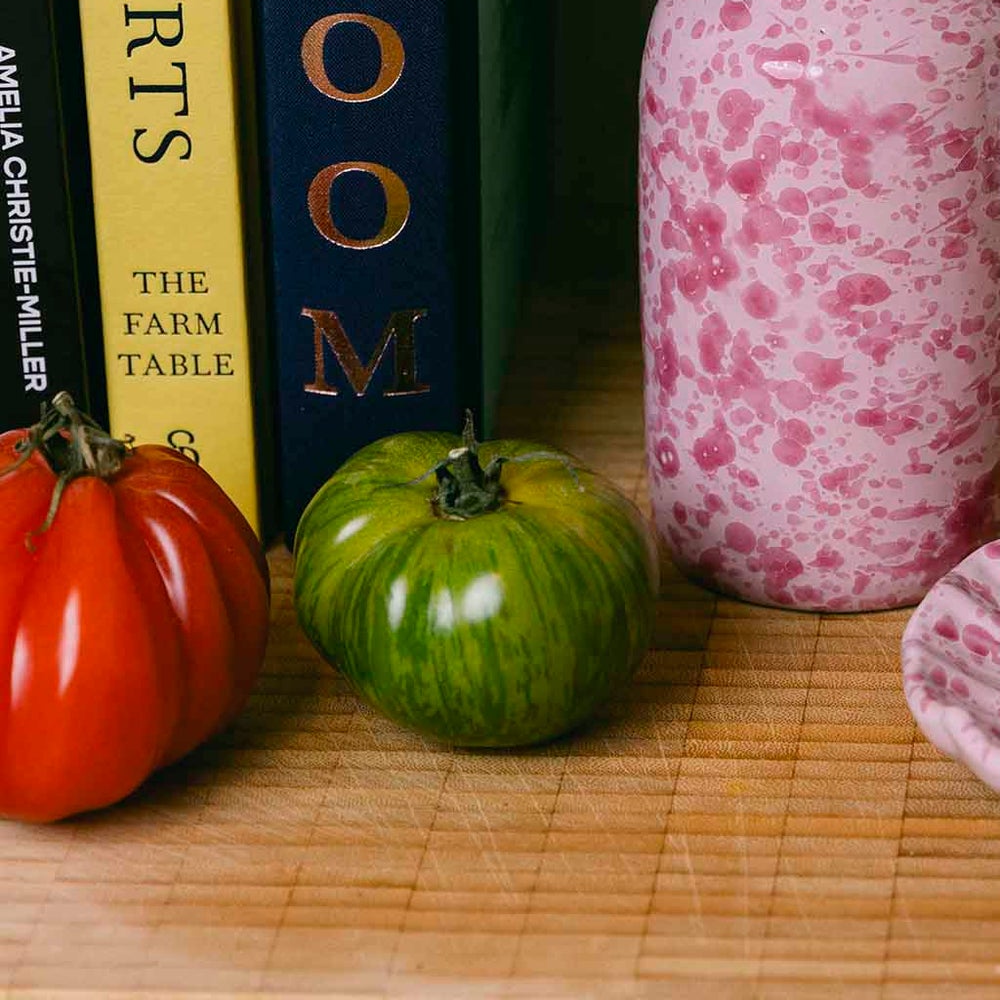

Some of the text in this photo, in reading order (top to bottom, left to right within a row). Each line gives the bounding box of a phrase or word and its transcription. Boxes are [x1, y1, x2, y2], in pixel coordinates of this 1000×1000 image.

[0, 45, 48, 393] AMELIA CHRISTIE-MILLER
[132, 271, 209, 294] THE
[122, 312, 224, 336] FARM
[117, 353, 235, 377] TABLE
